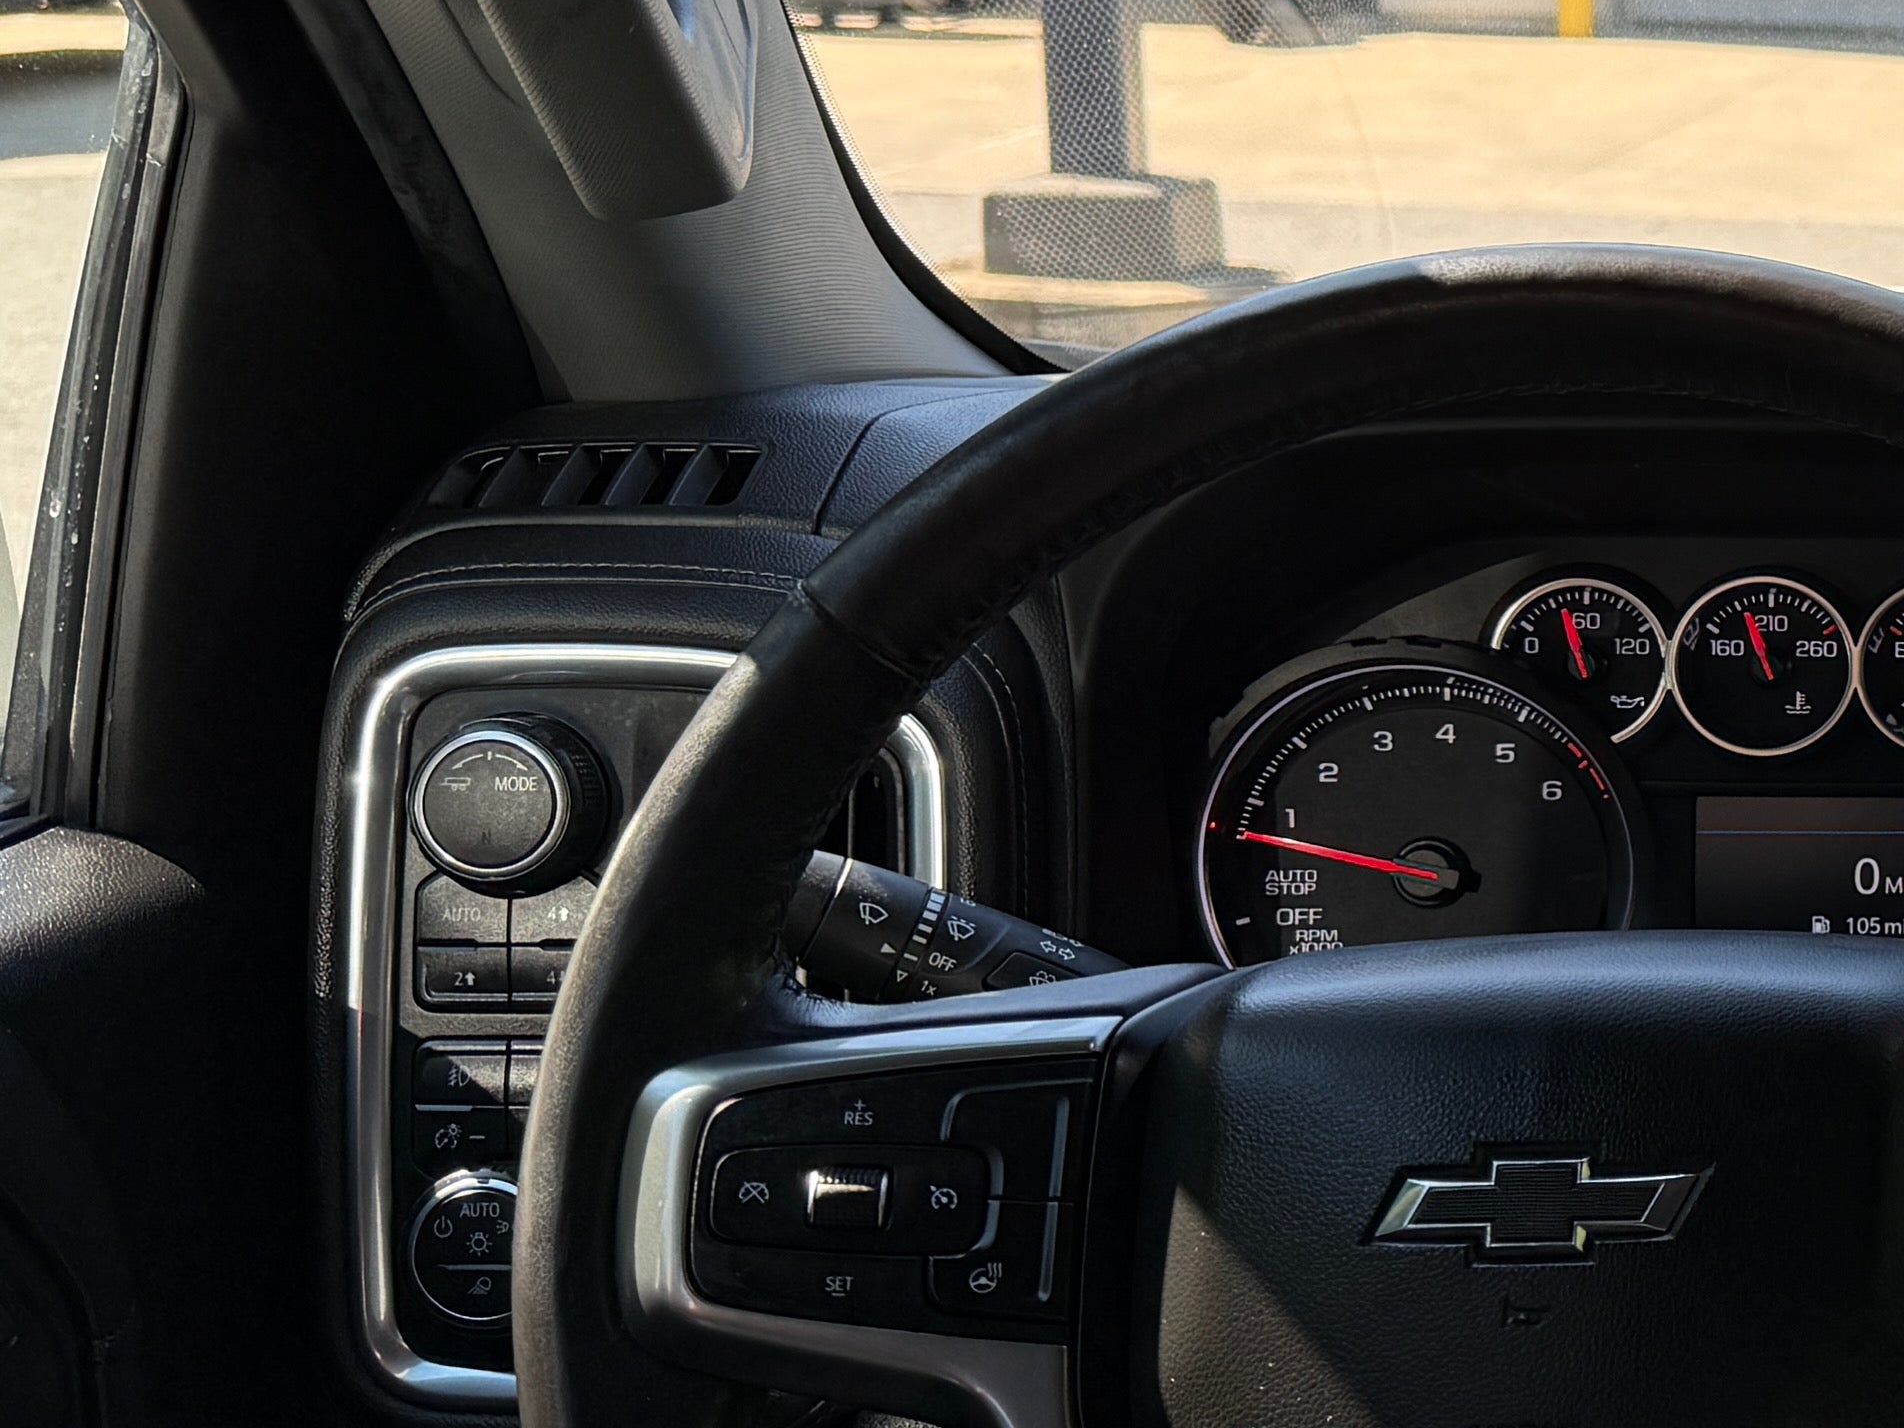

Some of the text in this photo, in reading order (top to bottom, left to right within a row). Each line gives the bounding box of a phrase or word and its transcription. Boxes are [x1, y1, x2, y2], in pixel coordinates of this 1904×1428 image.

[1571, 612, 1601, 630] 60
[1754, 615, 1789, 633] 210
[1524, 637, 1651, 656] 0 120
[1709, 639, 1838, 658] 160 260
[1372, 730, 1394, 754] 3
[1433, 722, 1457, 746] 4
[1493, 742, 1516, 766] 5
[1317, 761, 1340, 784] 2
[494, 775, 538, 794] MODE
[1541, 779, 1563, 802] 6
[1284, 808, 1297, 829] 1
[1264, 869, 1318, 883] AUTO
[1853, 856, 1880, 896] 0
[1264, 882, 1317, 896] STOP
[441, 907, 482, 923] AUTO
[1276, 907, 1323, 926] OFF
[1845, 916, 1883, 935] 105
[1295, 929, 1339, 942] RPM
[927, 951, 958, 972] OFF
[453, 971, 464, 987] 2
[546, 970, 556, 985] 4
[920, 979, 938, 997] 1x
[843, 1110, 874, 1127] RES
[458, 1201, 501, 1220] AUTO
[825, 1275, 854, 1293] SET
